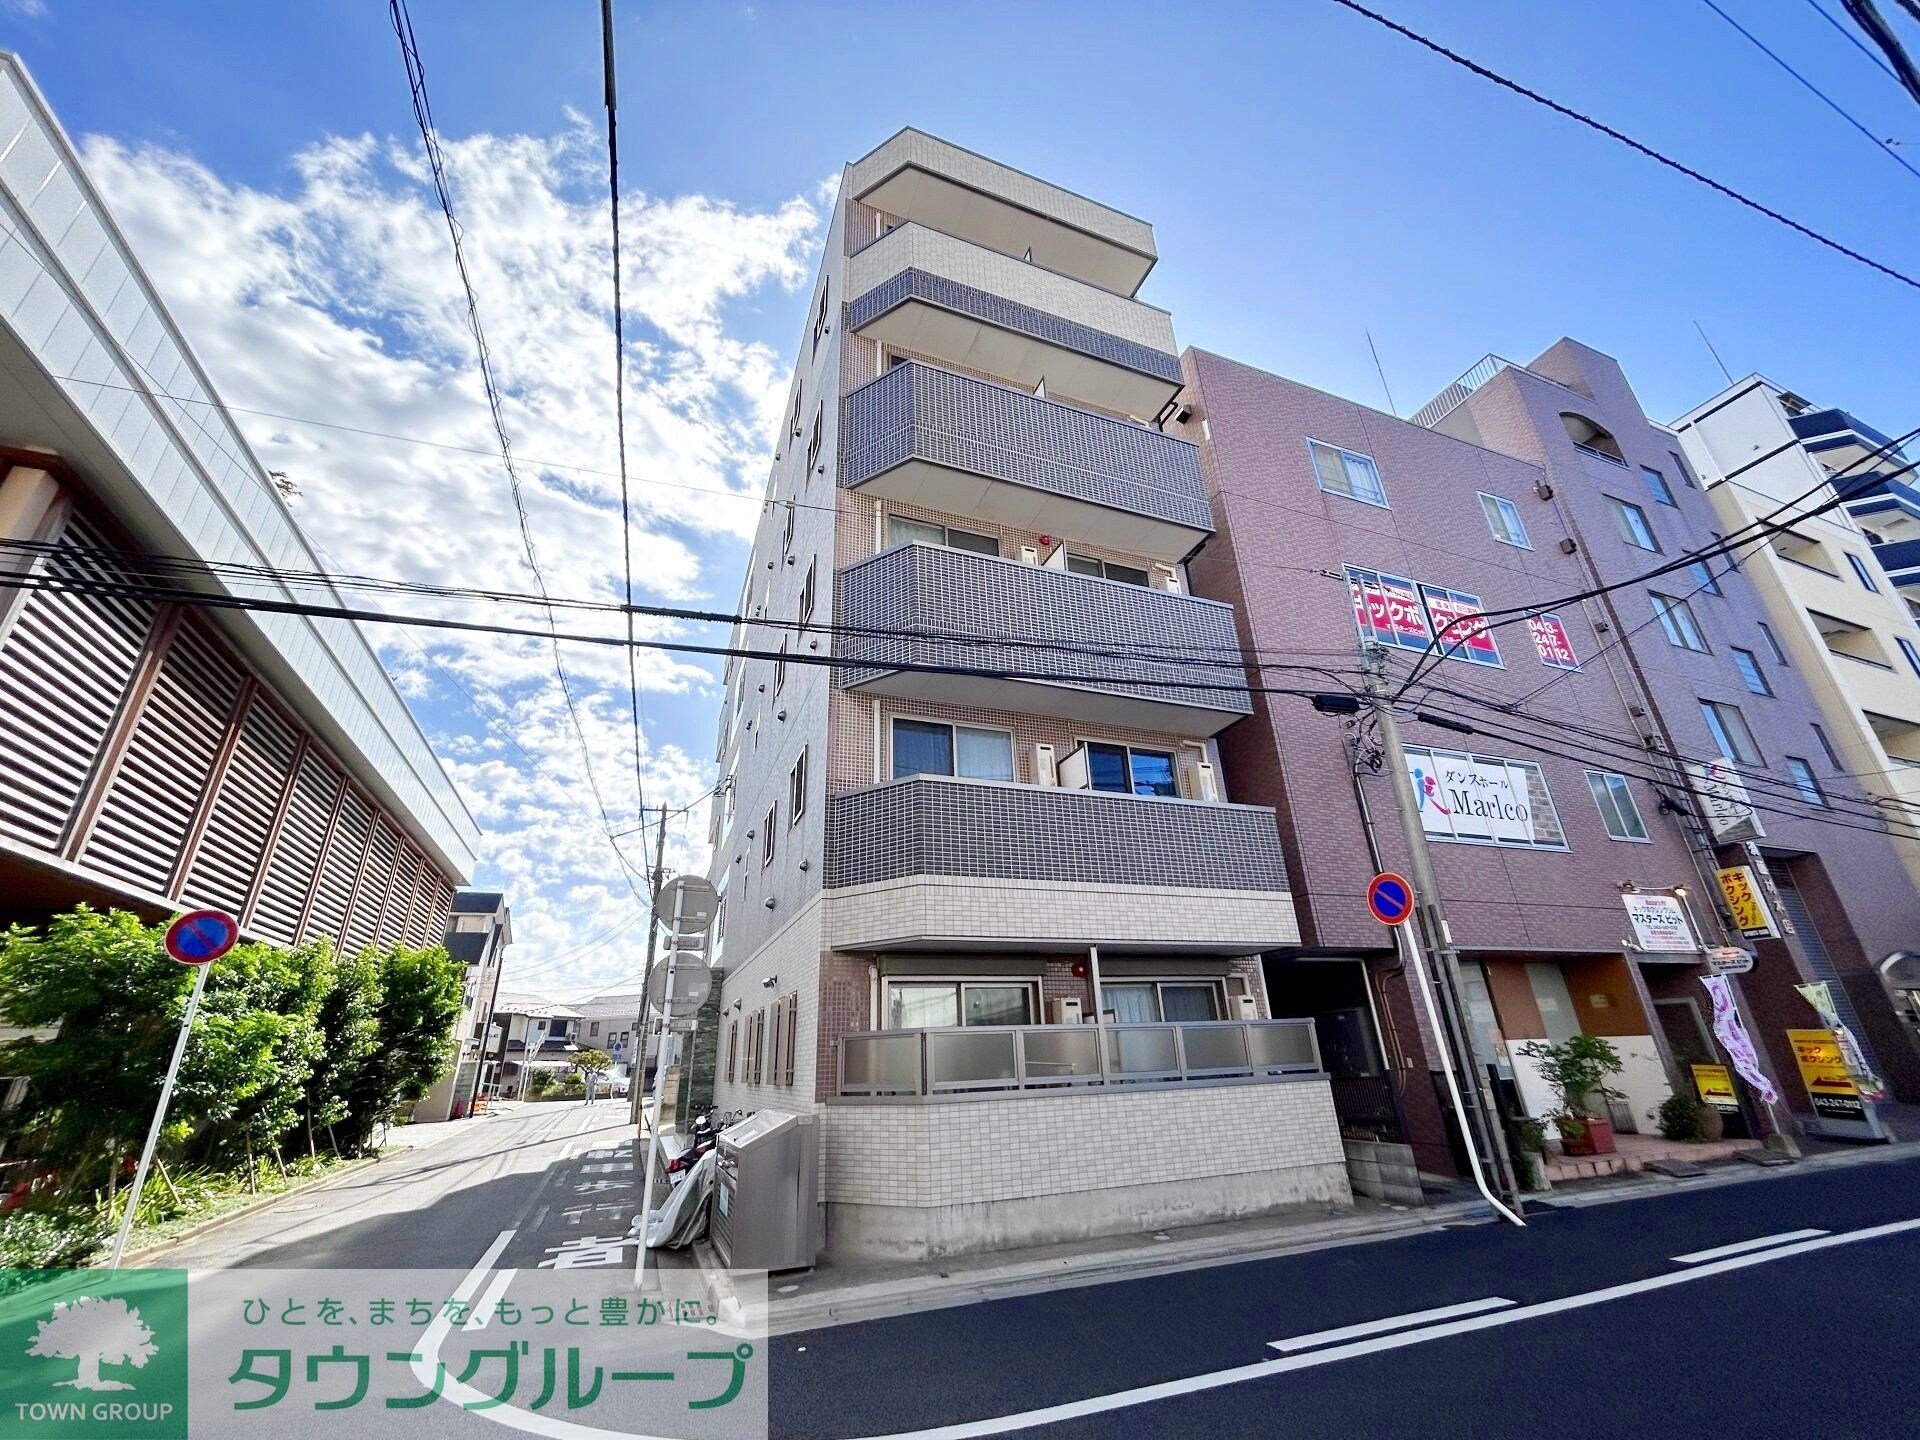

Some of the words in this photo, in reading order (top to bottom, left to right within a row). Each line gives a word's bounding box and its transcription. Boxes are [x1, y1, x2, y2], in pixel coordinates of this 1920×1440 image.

[1445, 770, 1509, 789] ダンスホール
[1720, 873, 1750, 927] ボクシング
[1732, 872, 1751, 902] キック
